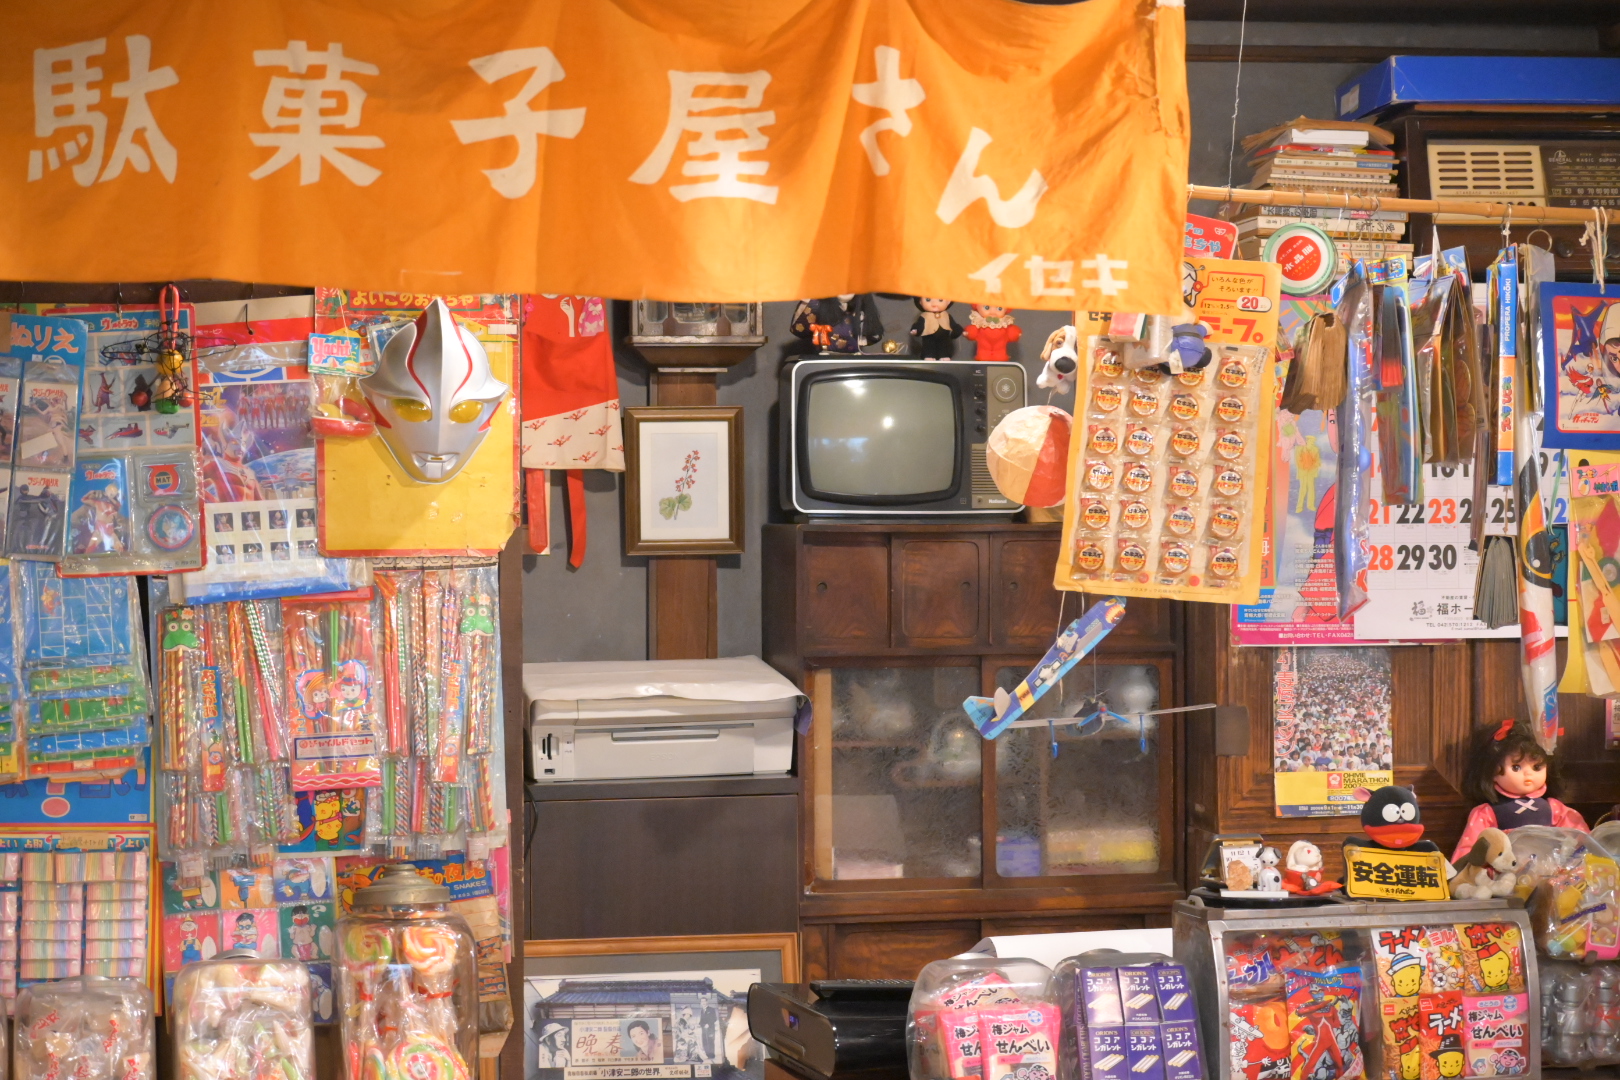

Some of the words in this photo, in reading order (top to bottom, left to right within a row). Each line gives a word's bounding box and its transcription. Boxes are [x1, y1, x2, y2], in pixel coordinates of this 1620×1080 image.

[27, 34, 1048, 228] 駄菓子屋さん
[968, 252, 1128, 297] イセキ
[353, 290, 474, 306] よいこのおちゃ
[1241, 296, 1259, 310] 20
[11, 322, 79, 353] ぬりえ
[311, 337, 352, 364] Yacht
[1225, 368, 1246, 377] セキスイ
[1220, 374, 1247, 384] カラーテープ
[1177, 399, 1197, 408] セキスイ
[1222, 402, 1243, 410] セキスイ
[1171, 405, 1199, 415] カラーテープ
[1217, 408, 1245, 417] カラーテープ
[1096, 435, 1115, 443] セキスイ
[1177, 433, 1198, 441] セキスイ
[1092, 441, 1117, 450] カラーテープ
[1172, 439, 1199, 449] カラーテープ
[1217, 443, 1244, 453] カラーテープ
[1176, 478, 1196, 486] セキスイ
[1171, 484, 1198, 493] カラーテープ
[1368, 498, 1390, 525] 21
[1396, 500, 1425, 524] 22
[1428, 498, 1457, 524] 23
[1491, 498, 1517, 524] 25
[1084, 514, 1110, 523] カラーテープ
[1169, 519, 1195, 529] カラーテープ
[1078, 557, 1104, 565] カラーテープ
[1119, 557, 1146, 565] カラーテープ
[1368, 545, 1394, 571] 28
[1396, 545, 1425, 571] 29
[1428, 544, 1457, 571] 30
[1211, 563, 1238, 571] カラーテープ
[1353, 860, 1440, 889] 安全運転
[454, 880, 487, 891] SNAKES
[1429, 1005, 1462, 1036] ラーメ
[1468, 1009, 1504, 1022] 梅ジャム
[991, 1024, 1030, 1036] 梅ジャム
[1472, 1025, 1523, 1040] せんべい
[1166, 1033, 1191, 1041] ココア
[576, 1032, 623, 1055] 晩春
[995, 1039, 1050, 1054] せんべい
[1095, 1044, 1121, 1052] シガレット
[1131, 1043, 1157, 1051] シガレット
[1167, 1041, 1193, 1049] シガレット
